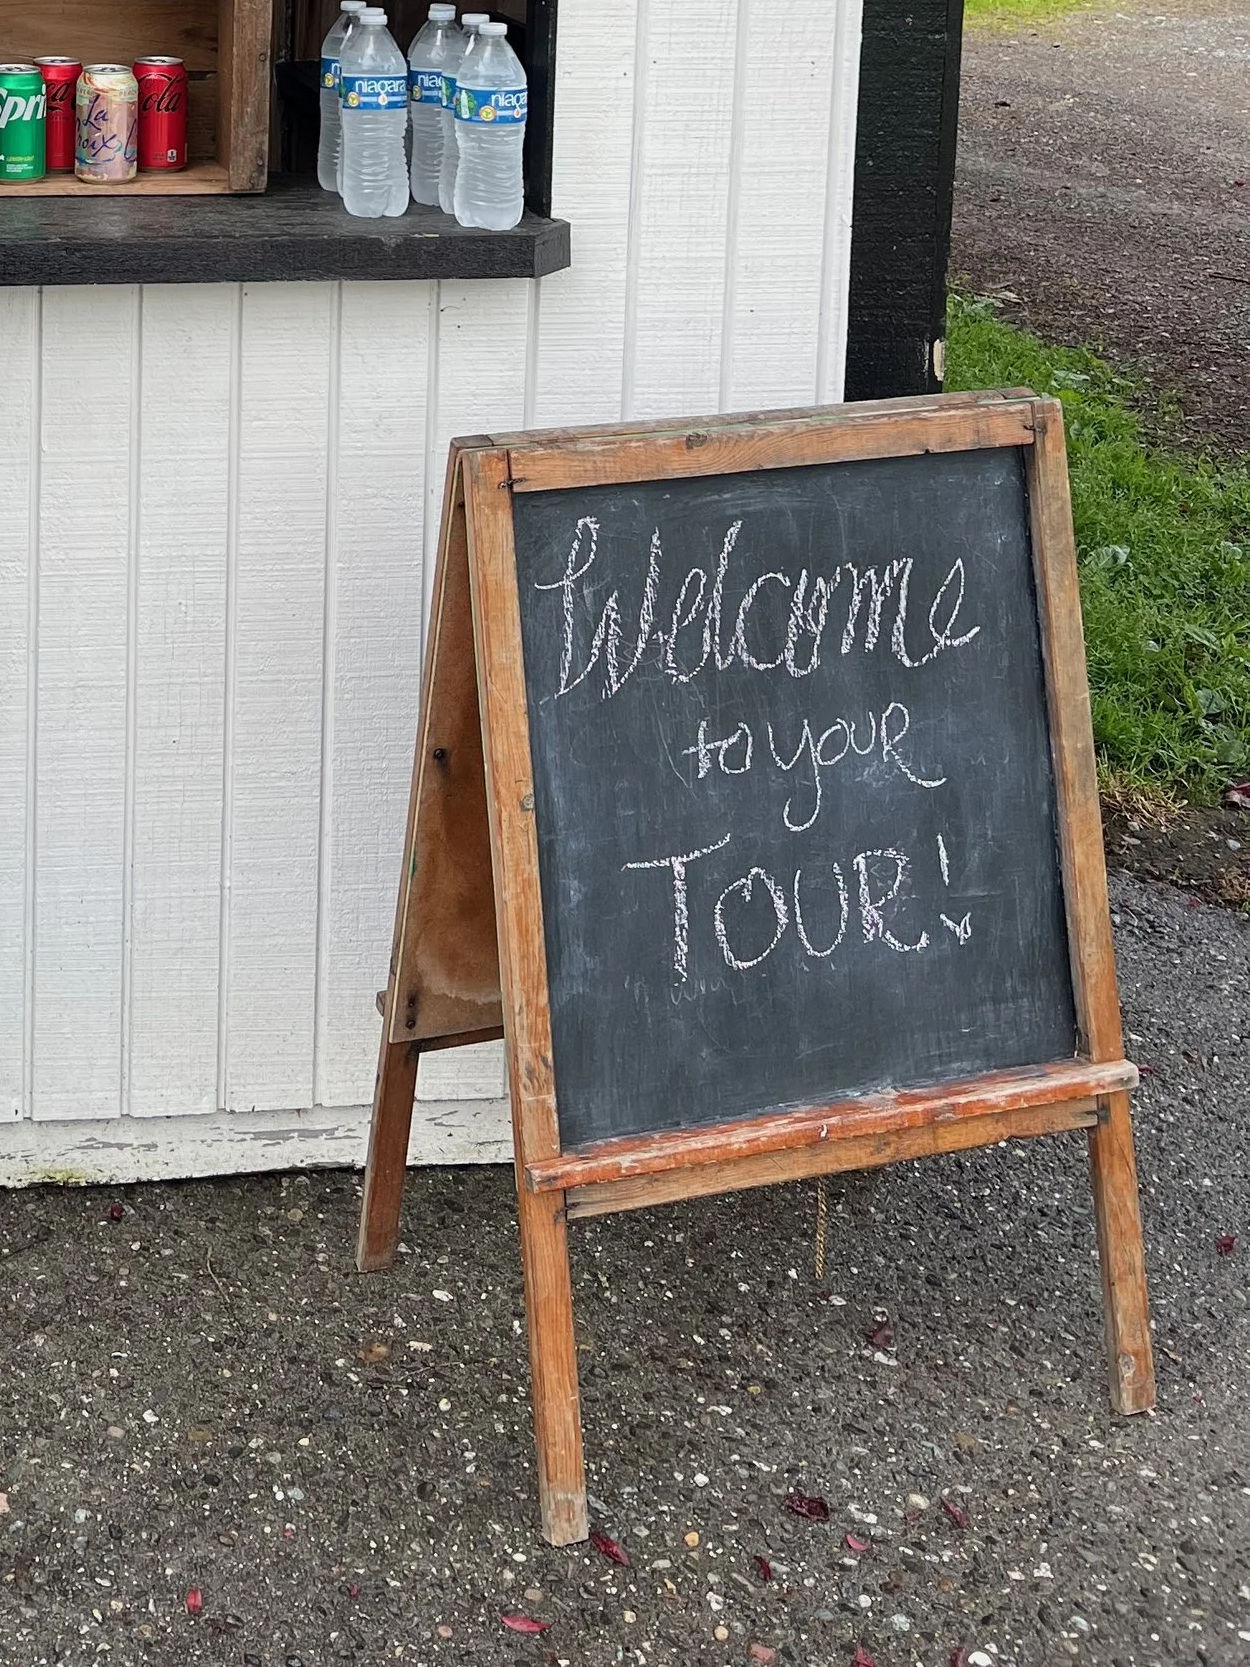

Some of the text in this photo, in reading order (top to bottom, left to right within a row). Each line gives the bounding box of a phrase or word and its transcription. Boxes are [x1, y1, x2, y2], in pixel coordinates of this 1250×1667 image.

[83, 94, 109, 131] La
[355, 79, 406, 96] niagara
[534, 515, 981, 700] Welcome
[682, 720, 752, 779] to
[621, 833, 972, 974] TOUR!
